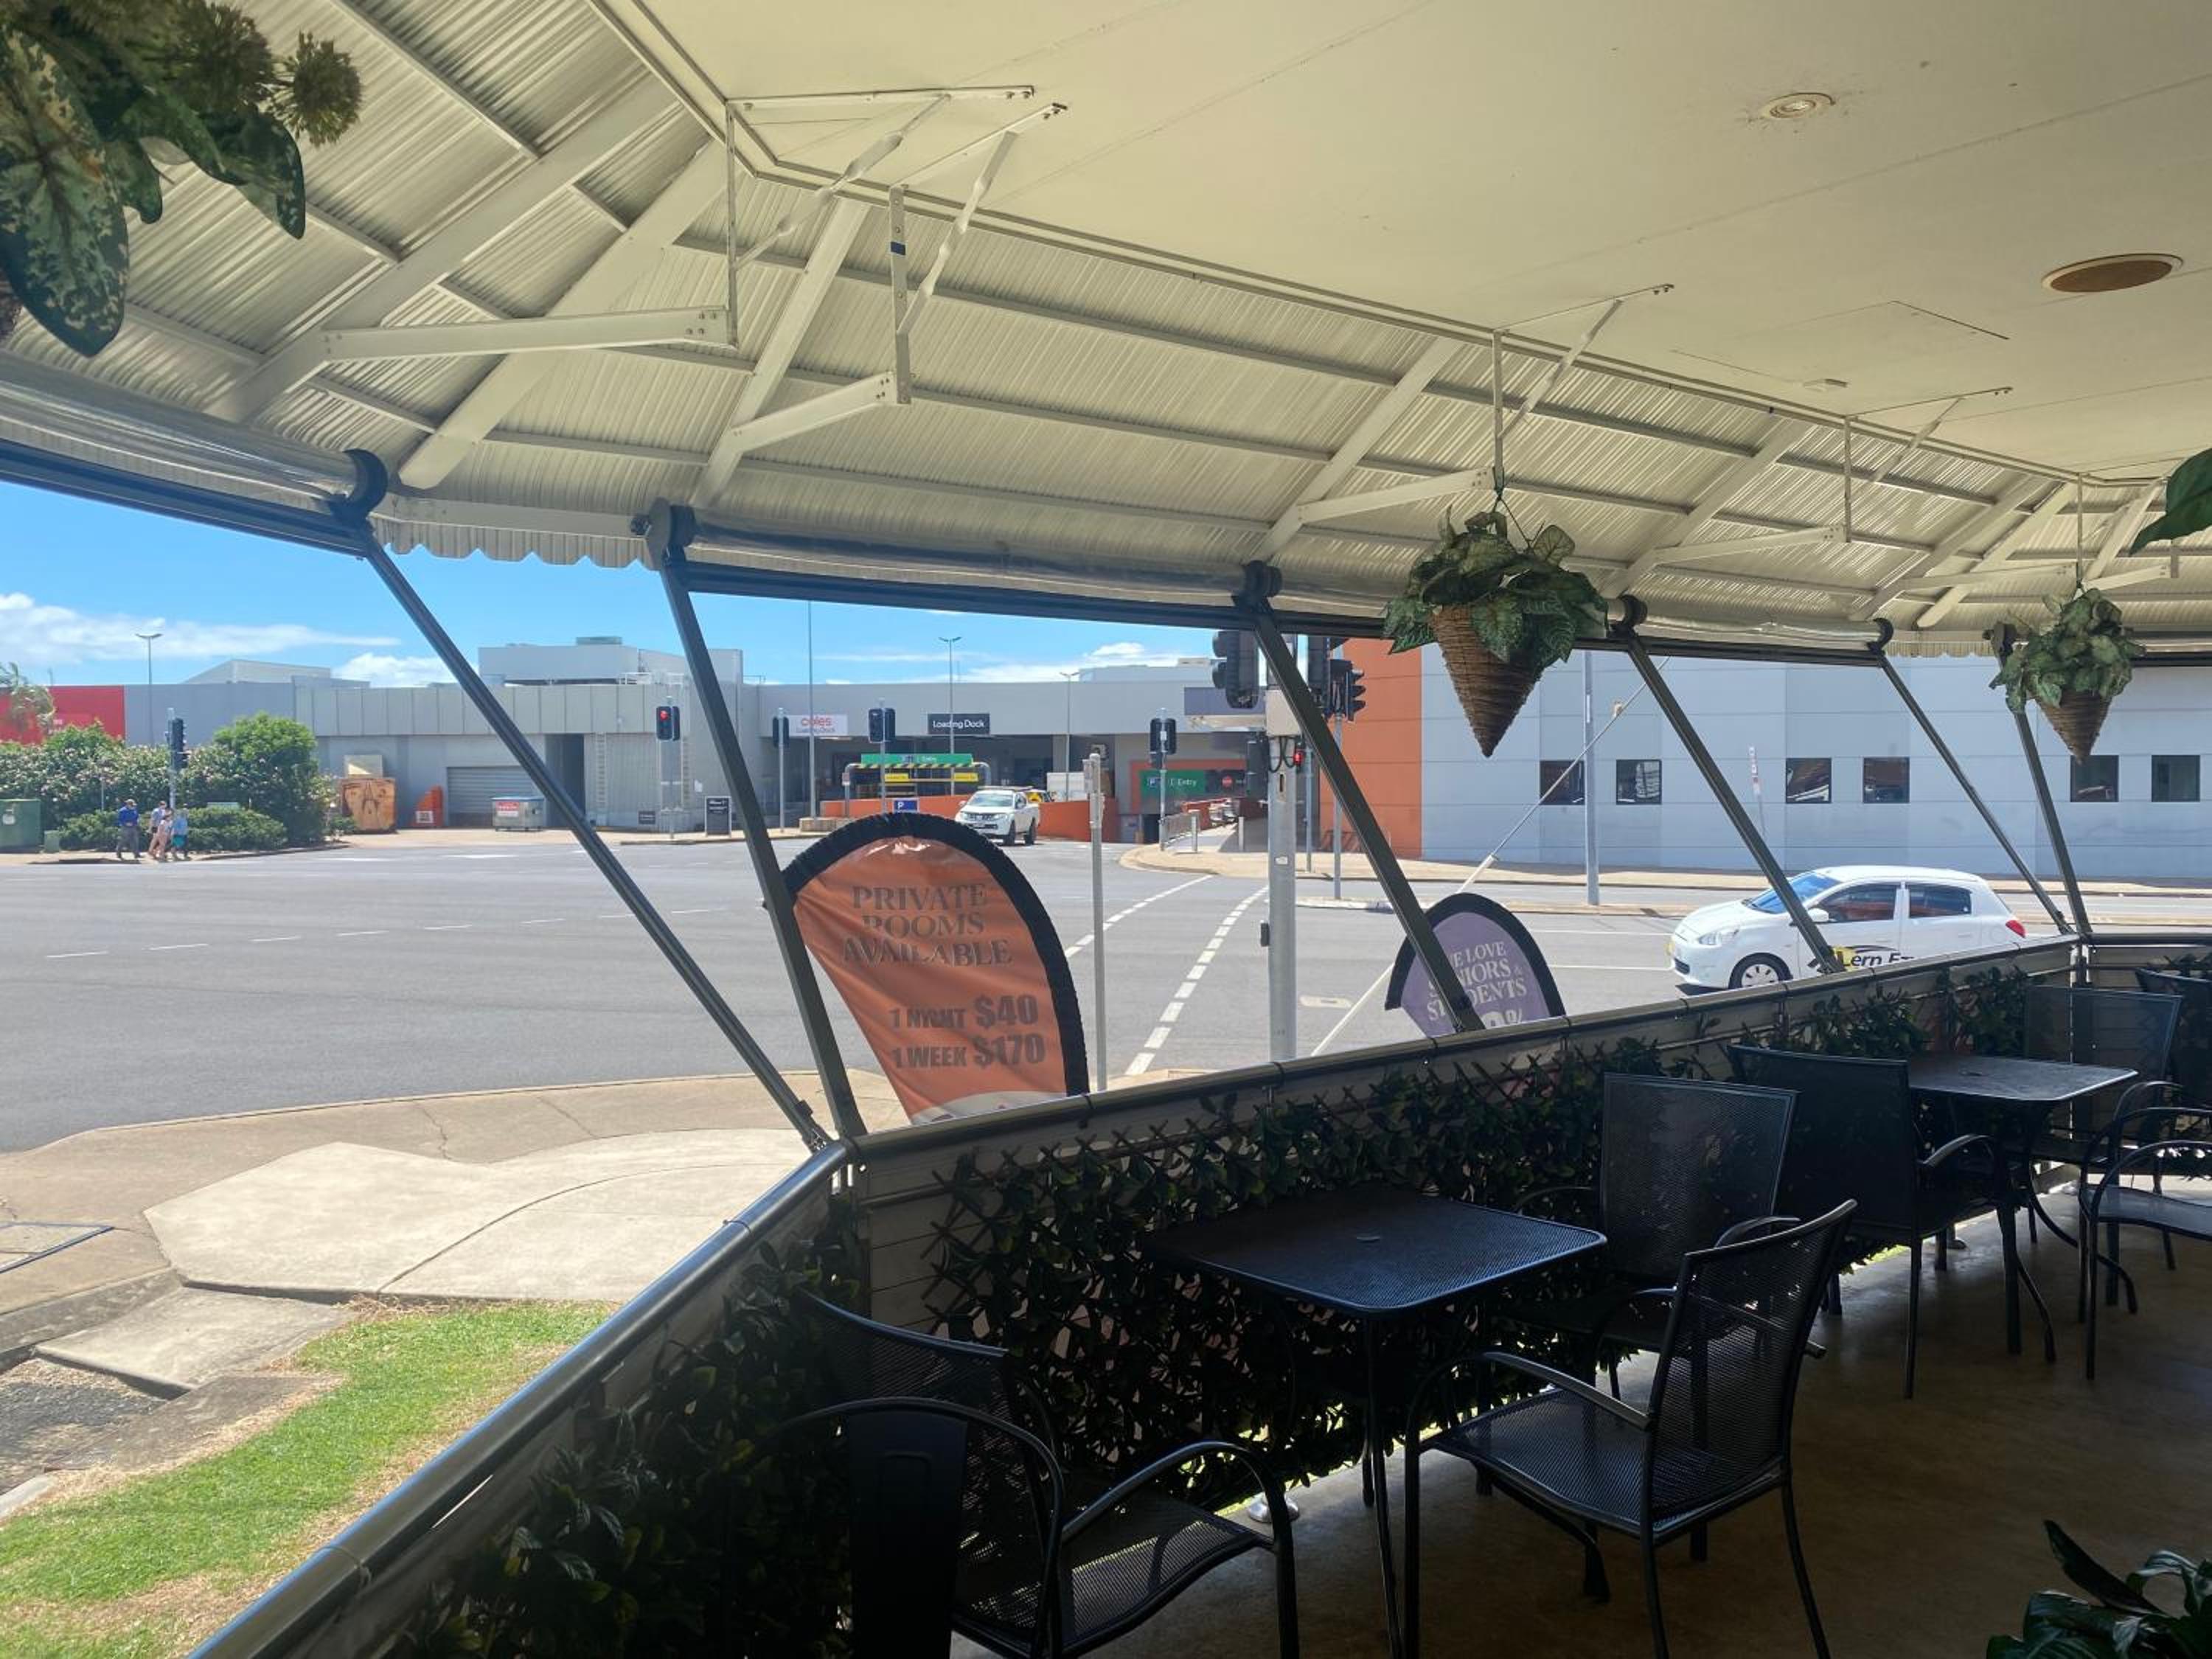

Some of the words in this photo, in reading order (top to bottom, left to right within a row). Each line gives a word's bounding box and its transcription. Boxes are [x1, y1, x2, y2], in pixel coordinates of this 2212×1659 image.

[932, 720, 963, 728] Loadng
[964, 719, 984, 728] Dock
[852, 884, 989, 911] PRIVATE
[863, 911, 984, 938] ROOMS
[844, 939, 1013, 967] AVAILABLE
[1467, 942, 1506, 962] LOVE
[890, 1009, 900, 1028] 1
[974, 994, 1038, 1028] $40
[1427, 977, 1527, 1021] STDENTS
[892, 1048, 902, 1068] 1
[907, 1046, 967, 1068] WEEK
[973, 1033, 1046, 1069] $170
